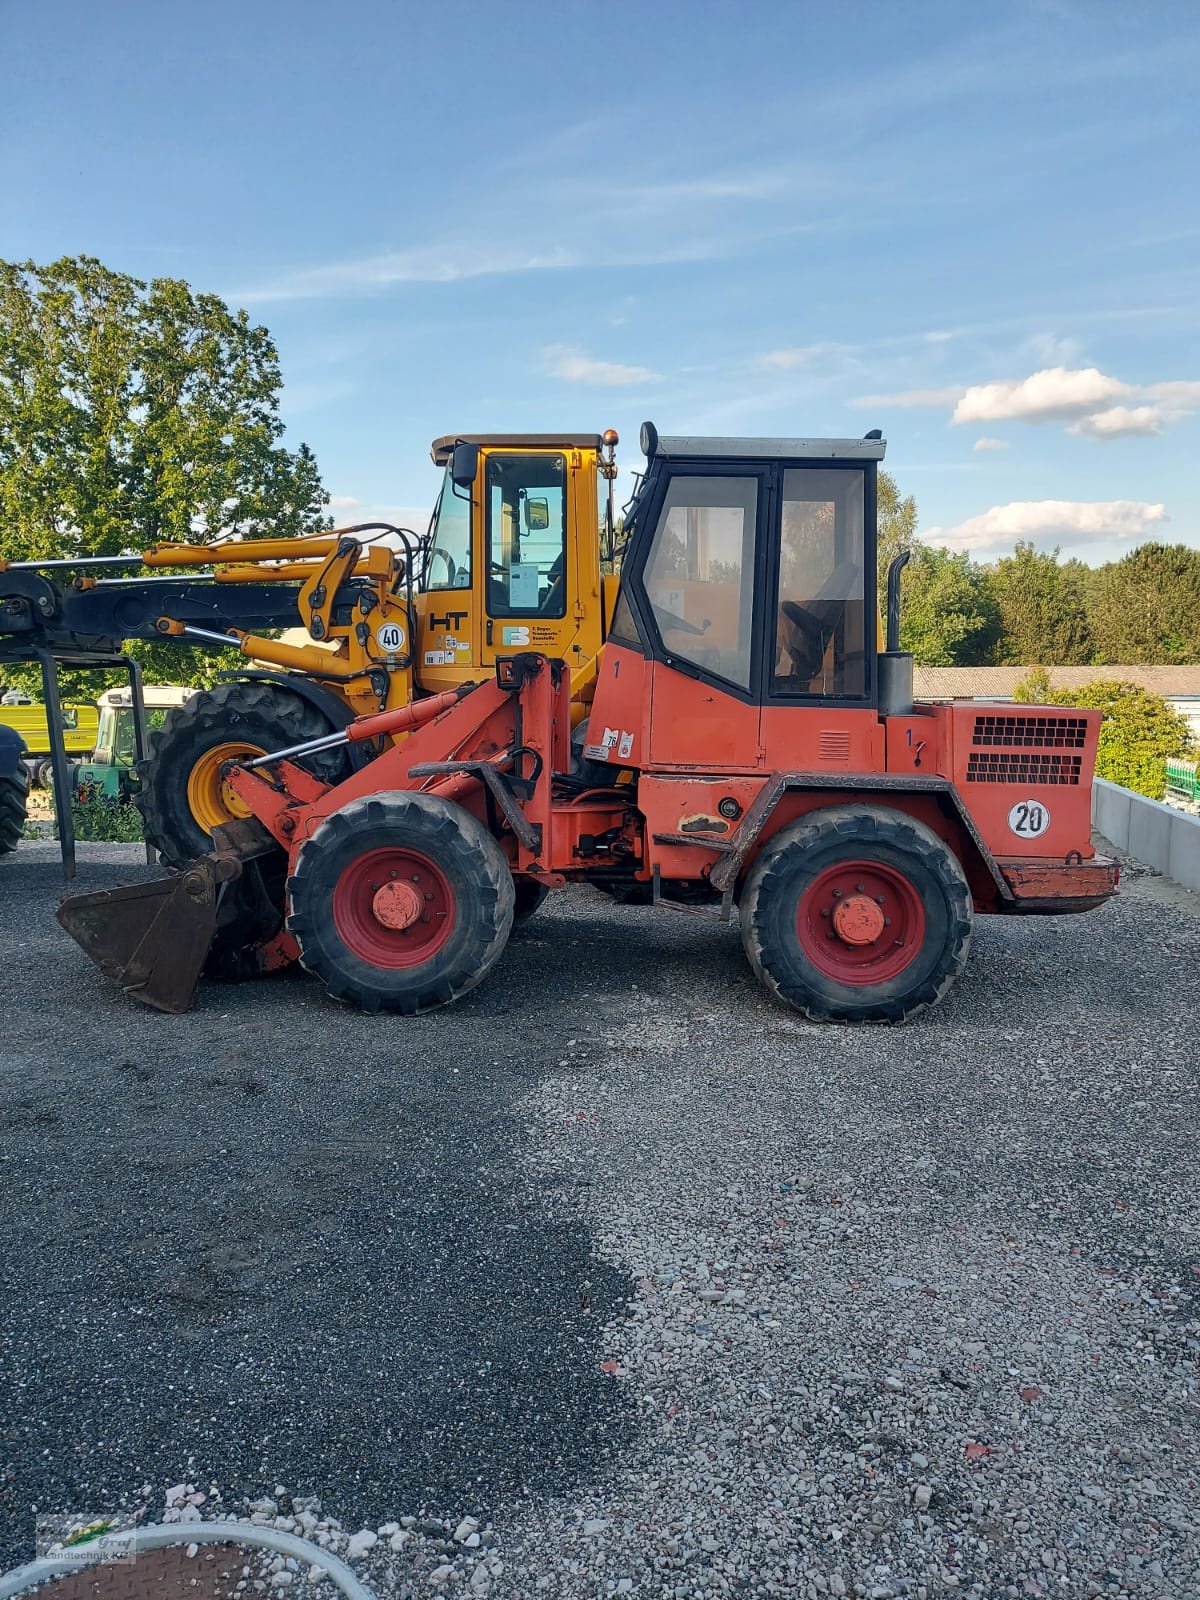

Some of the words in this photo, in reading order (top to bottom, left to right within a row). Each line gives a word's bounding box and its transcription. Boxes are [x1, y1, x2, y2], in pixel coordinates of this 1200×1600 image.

[430, 611, 468, 631] HT
[383, 629, 399, 646] 40
[614, 660, 620, 678] 1
[905, 729, 913, 747] 1
[1015, 804, 1043, 832] 20
